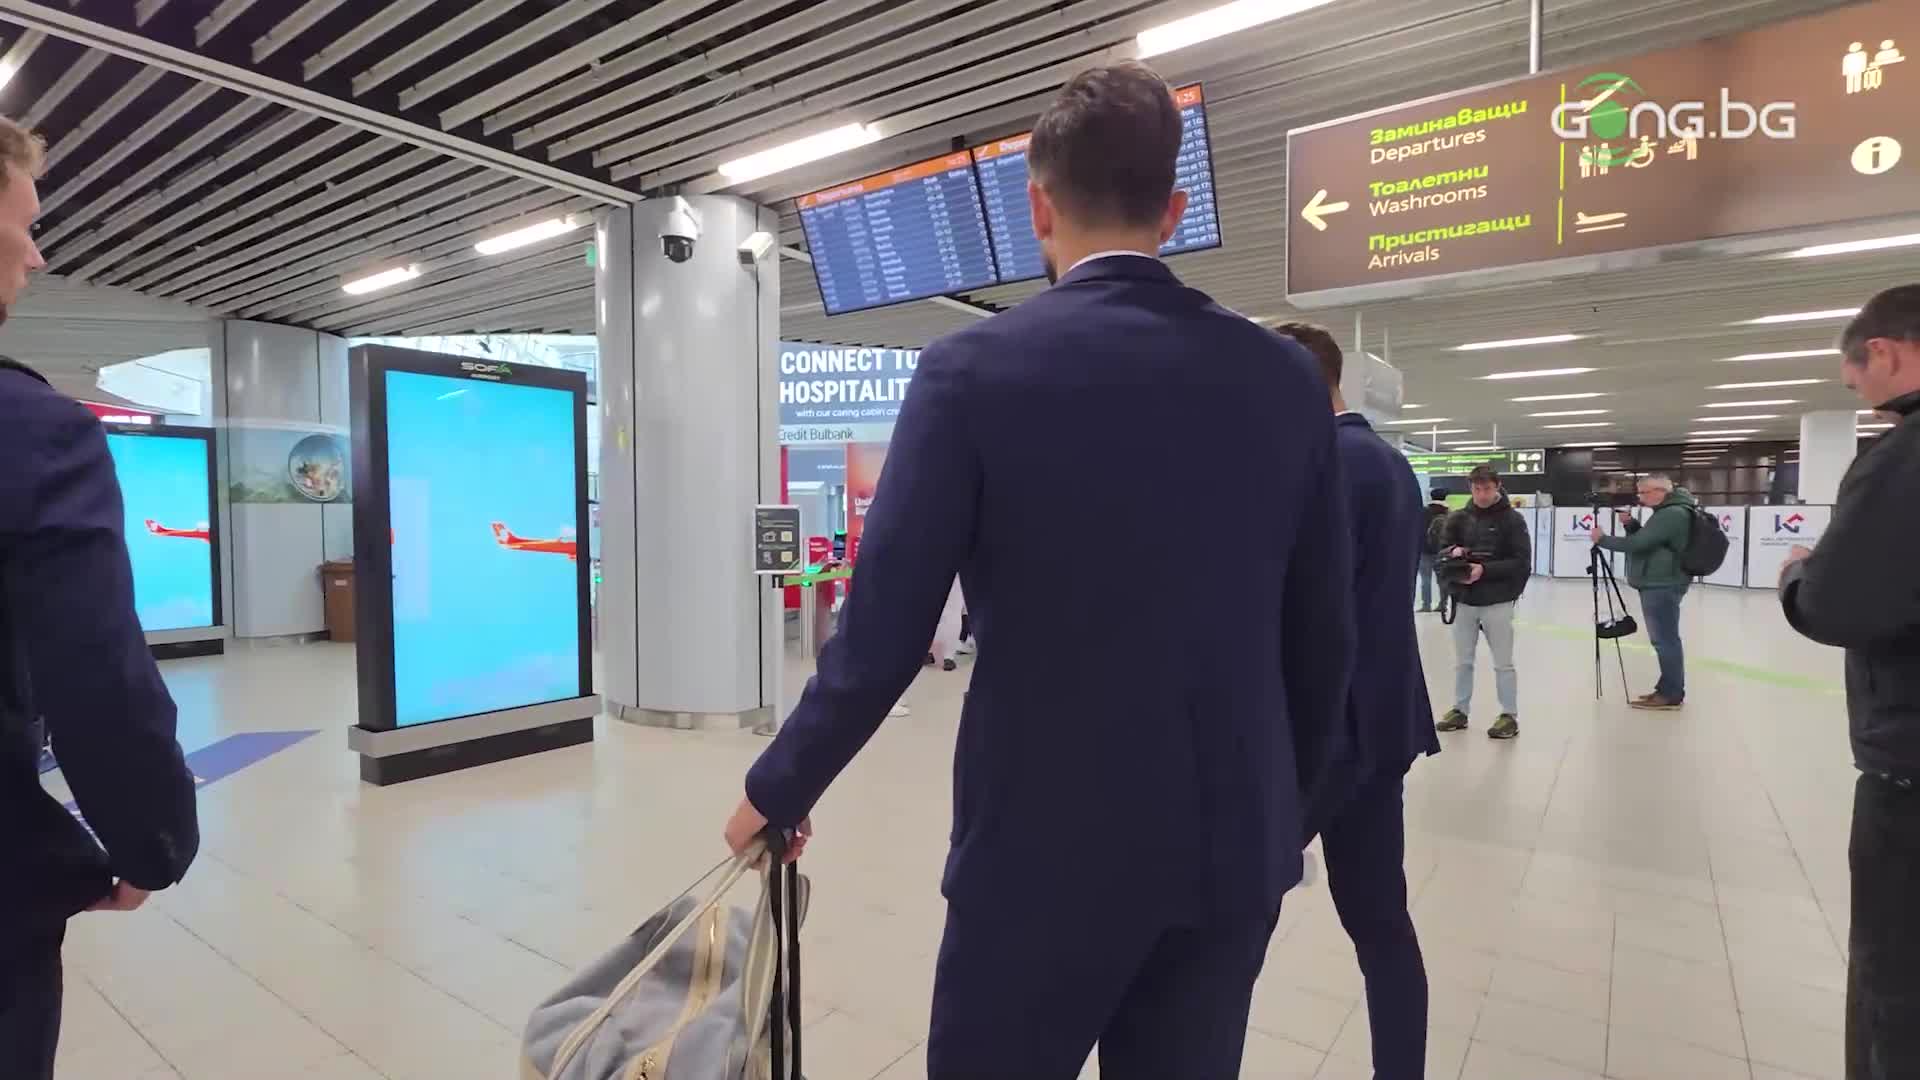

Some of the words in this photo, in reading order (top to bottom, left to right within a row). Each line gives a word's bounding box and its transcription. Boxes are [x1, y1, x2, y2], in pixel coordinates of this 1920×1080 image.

[1369, 100, 1529, 146] Заминаващи
[1370, 129, 1487, 165] Departures
[1369, 165, 1489, 198] Тоалетни
[1369, 184, 1488, 217] Washrooms
[1368, 213, 1532, 252] Пристигащи
[1368, 246, 1441, 270] Arrivals
[781, 349, 887, 374] CONNECT
[780, 378, 912, 404] HOSPITALIT
[811, 427, 853, 440] Bulbank
